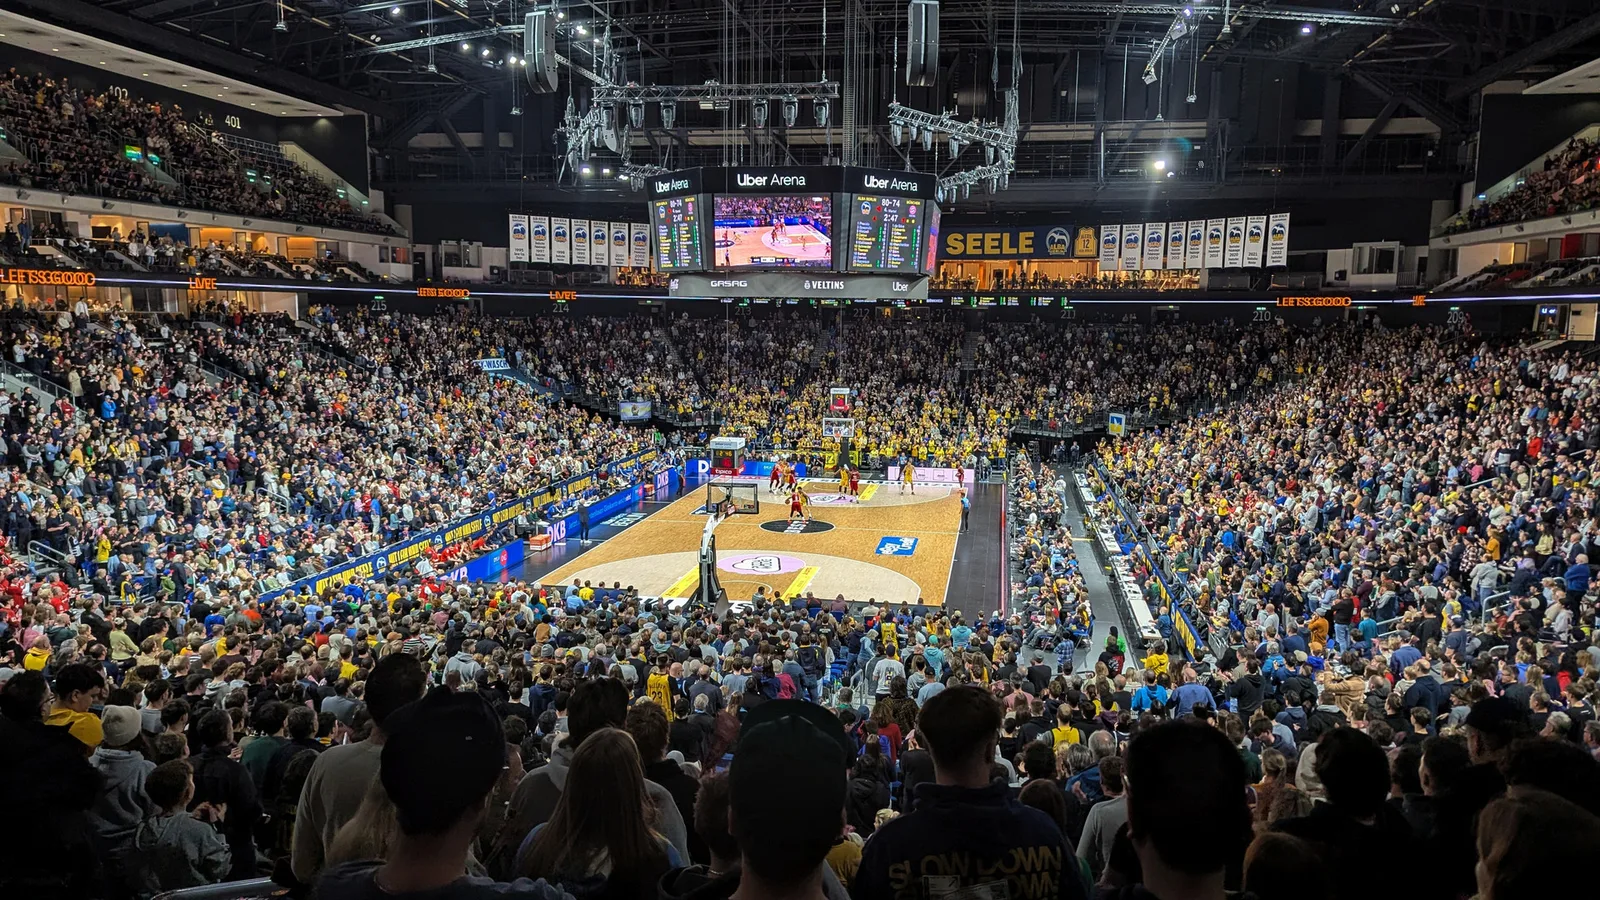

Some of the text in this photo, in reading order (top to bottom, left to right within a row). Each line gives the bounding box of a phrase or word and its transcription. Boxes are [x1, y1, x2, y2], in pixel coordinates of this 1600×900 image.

[225, 114, 241, 129] 401
[737, 173, 806, 186] Uber Arena
[864, 175, 918, 192] Uber Arena
[655, 179, 689, 193] Uber Arena
[881, 199, 900, 207] 80-74
[883, 214, 899, 222] 2:47
[946, 231, 1035, 255] SEELE
[1083, 239, 1090, 249] 12
[811, 280, 845, 290] VELTINS
[892, 281, 909, 292] Uber
[371, 300, 387, 311] 215
[552, 303, 570, 313] 214
[853, 308, 870, 318] 212
[1252, 311, 1271, 322] 210
[657, 470, 669, 489] DKB
[547, 520, 566, 544] DKB
[887, 851, 970, 890] SLOW
